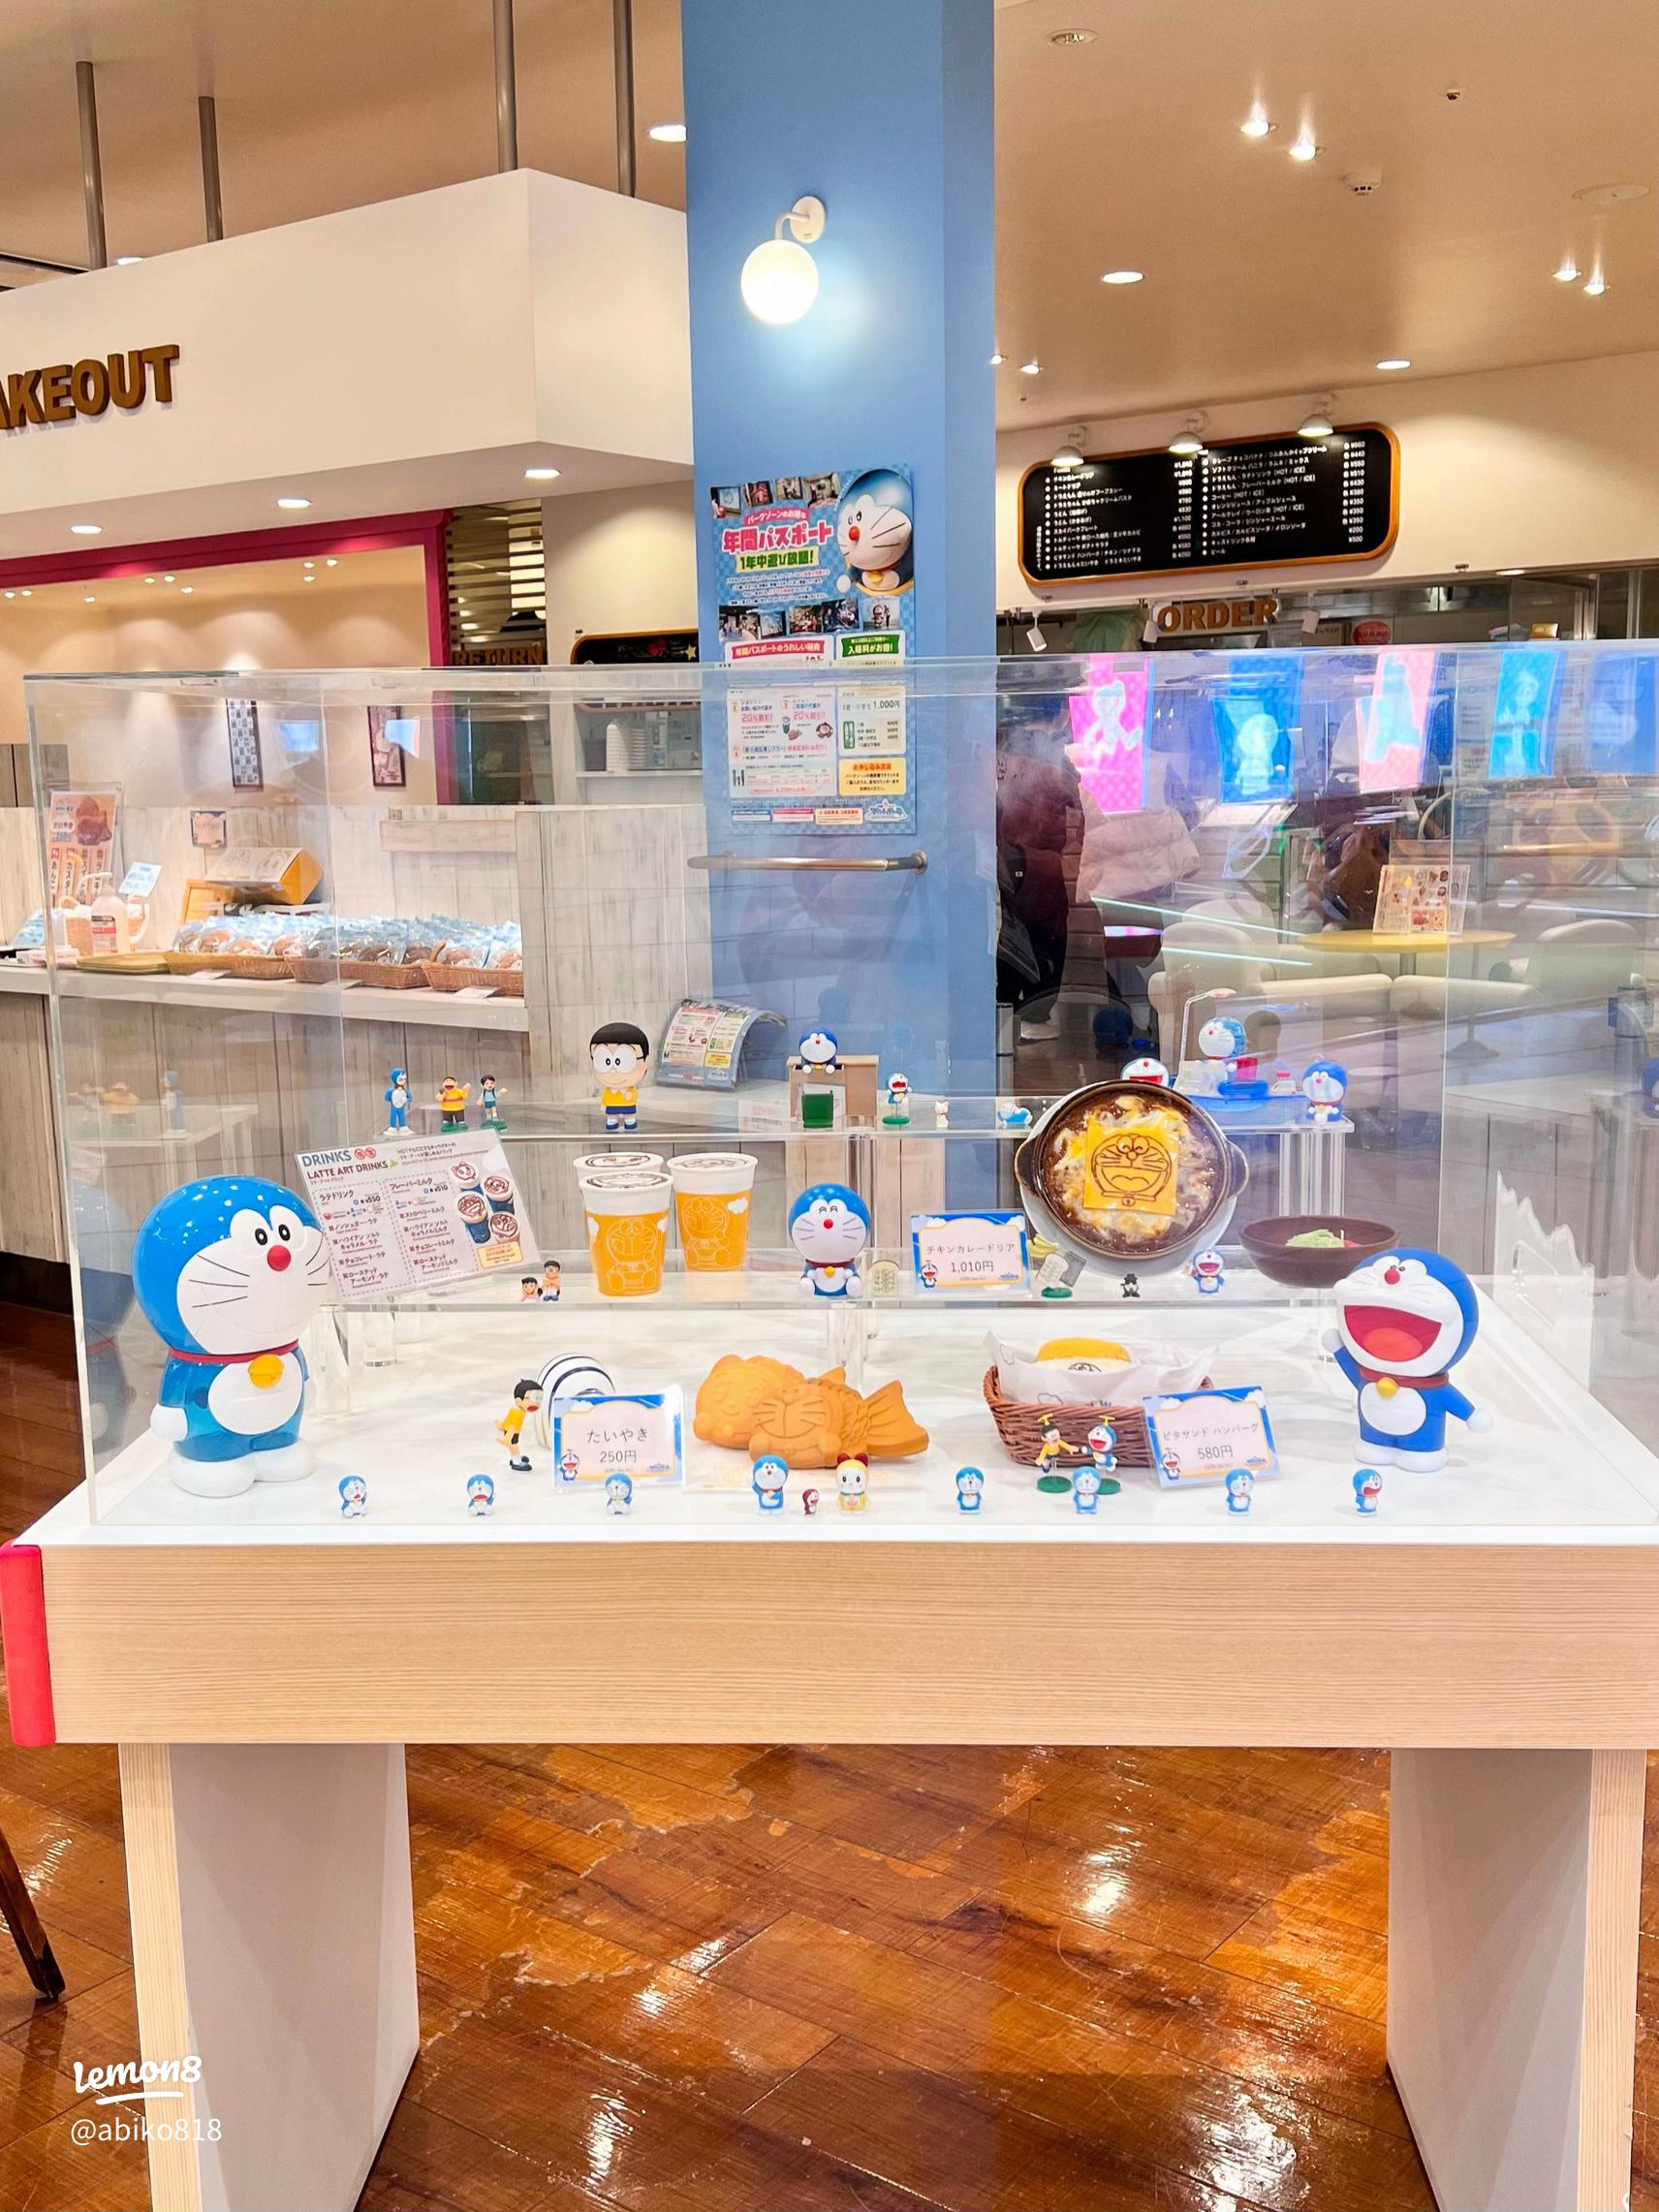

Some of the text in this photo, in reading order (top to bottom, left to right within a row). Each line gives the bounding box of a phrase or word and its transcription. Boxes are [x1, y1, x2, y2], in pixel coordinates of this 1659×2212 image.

[723, 521, 833, 551] 年間パスポート
[1157, 599, 1277, 632] ORDER
[873, 700, 900, 709] 1,000円
[302, 1149, 352, 1168] DRINKS
[307, 1160, 388, 1179] LATTE ART DRINKS
[390, 1177, 433, 1191] フレーバーミルク
[319, 1189, 354, 1201] ラテドリンク
[404, 1205, 445, 1218] ストロベリーミルク
[925, 1242, 1016, 1256] チキンカレードリア
[950, 1260, 995, 1274] 1,010円
[586, 1426, 649, 1444] たいやき
[1162, 1422, 1259, 1441] ピタサンド ハンバーグ
[599, 1449, 638, 1464] 250円
[1197, 1445, 1235, 1460] 580円
